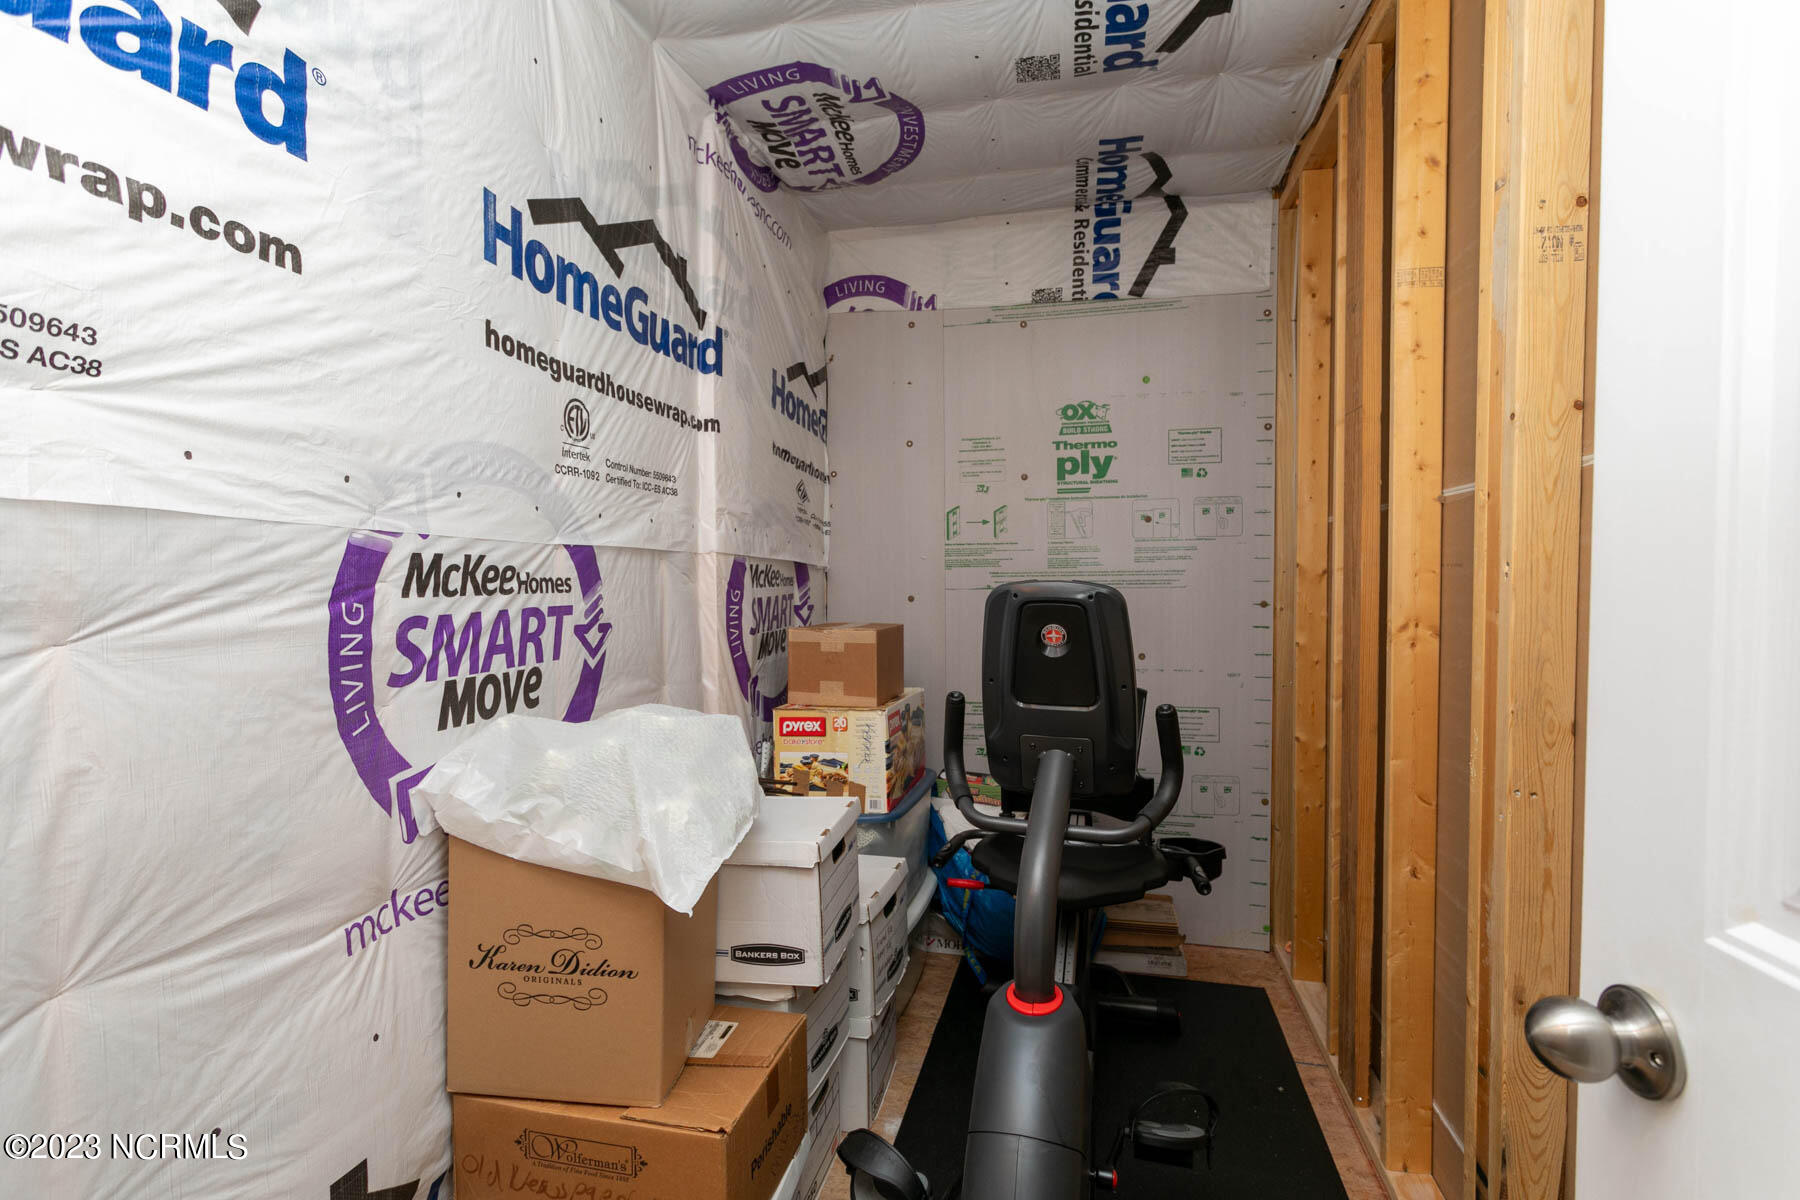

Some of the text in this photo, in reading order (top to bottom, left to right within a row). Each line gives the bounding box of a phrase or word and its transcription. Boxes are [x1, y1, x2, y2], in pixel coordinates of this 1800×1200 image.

[727, 68, 801, 95] LIVING
[761, 95, 846, 178] SMART
[483, 186, 723, 378] HomeGuard
[835, 279, 886, 298] LIVING
[26, 345, 102, 378] AC38
[561, 446, 591, 463] Intertek
[1052, 440, 1118, 451] Thermo
[555, 463, 600, 482] CCRR-1092
[605, 458, 629, 474] Control
[605, 473, 632, 488] Certified
[1056, 449, 1114, 481] ply
[728, 589, 743, 659] LIVING
[750, 594, 795, 635] SMART
[386, 604, 574, 689] SMART
[340, 601, 371, 737] LIVING
[782, 719, 822, 735] pyrex
[833, 717, 847, 728] 20
[344, 879, 449, 957] mckee
[469, 943, 639, 980] Karen Didion
[735, 949, 800, 961] BANKERS BOX
[523, 975, 583, 986] ORIGINALS
[531, 1134, 628, 1173] Wolferman's
[750, 1103, 793, 1180] Perishable
[461, 1153, 503, 1193] Old
